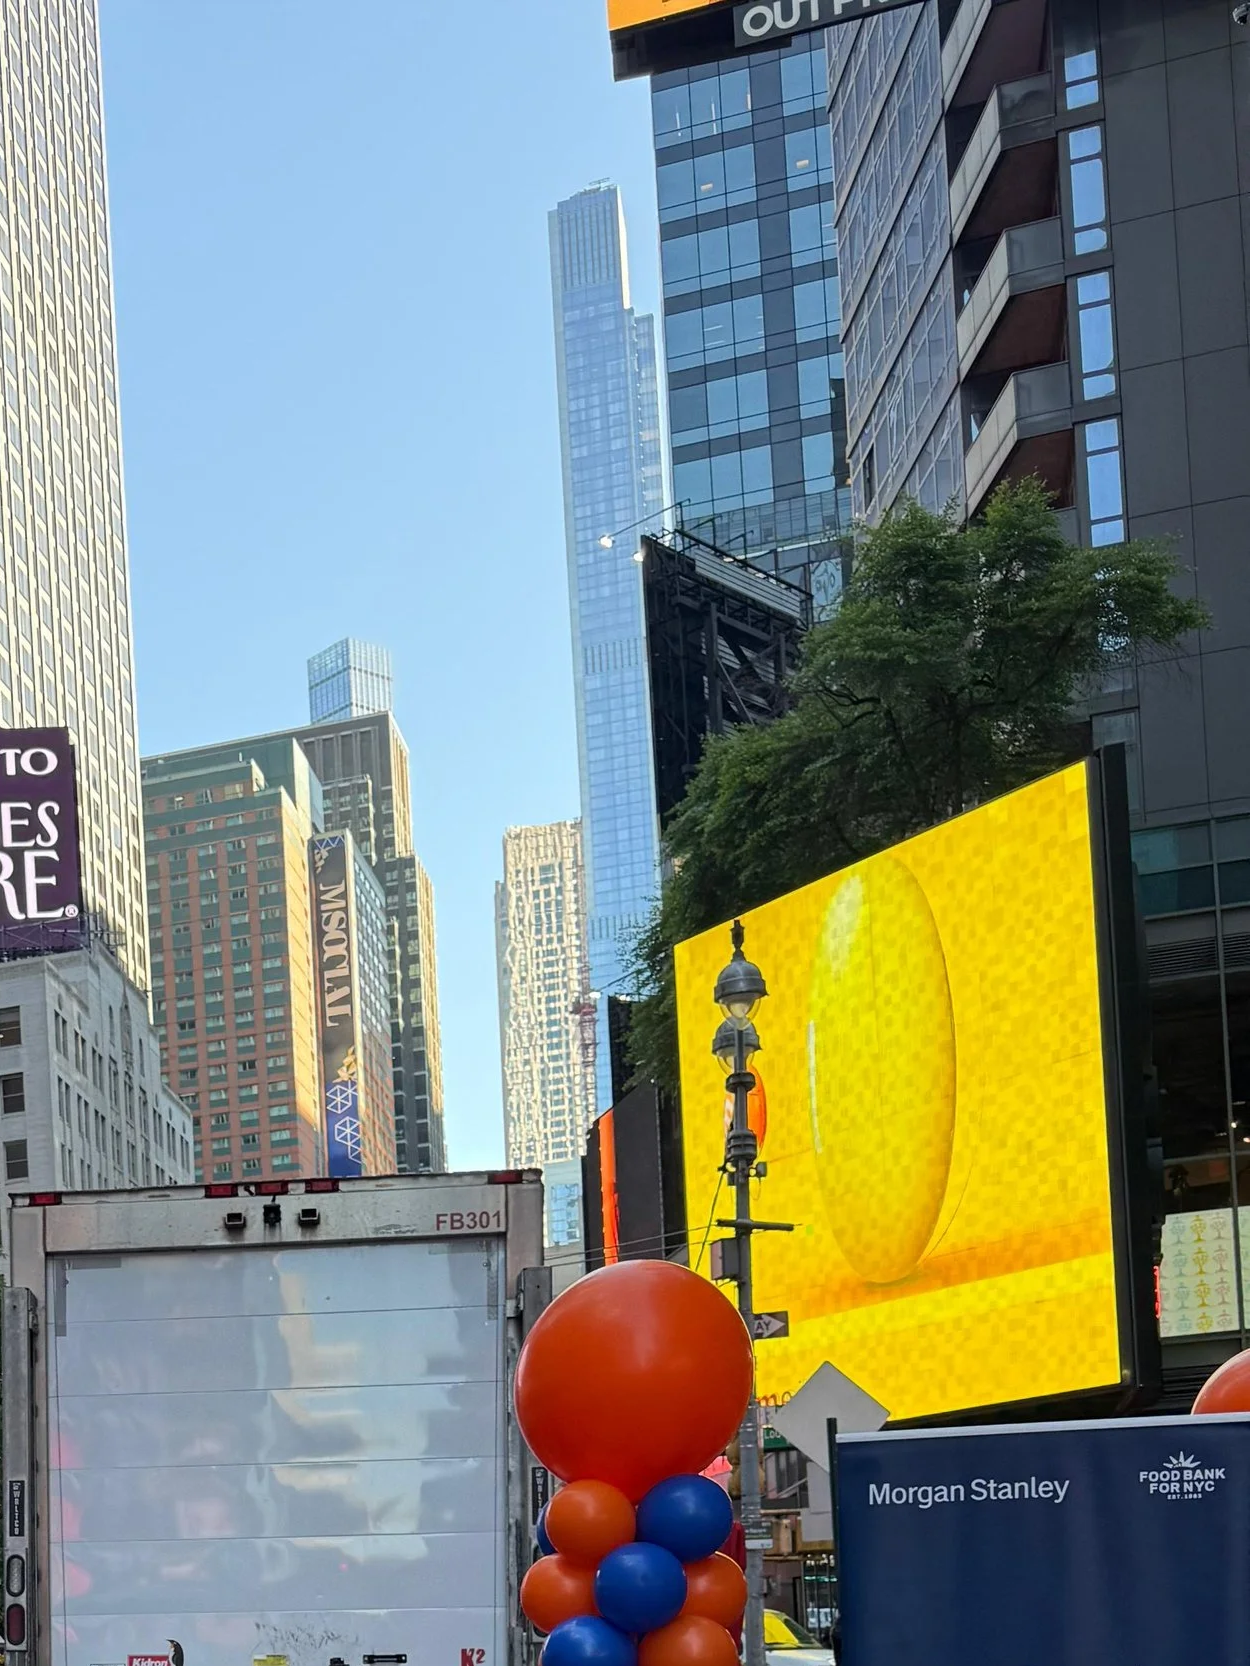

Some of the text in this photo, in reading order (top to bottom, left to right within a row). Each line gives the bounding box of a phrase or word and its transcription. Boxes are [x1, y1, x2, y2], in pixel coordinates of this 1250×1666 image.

[0, 748, 58, 777] TO
[436, 1210, 501, 1231] FB301
[755, 1320, 772, 1332] AY
[1139, 1467, 1226, 1483] FOOD BANK
[869, 1476, 1070, 1509] Morgan Stanley
[1149, 1480, 1215, 1494] FOR NYC
